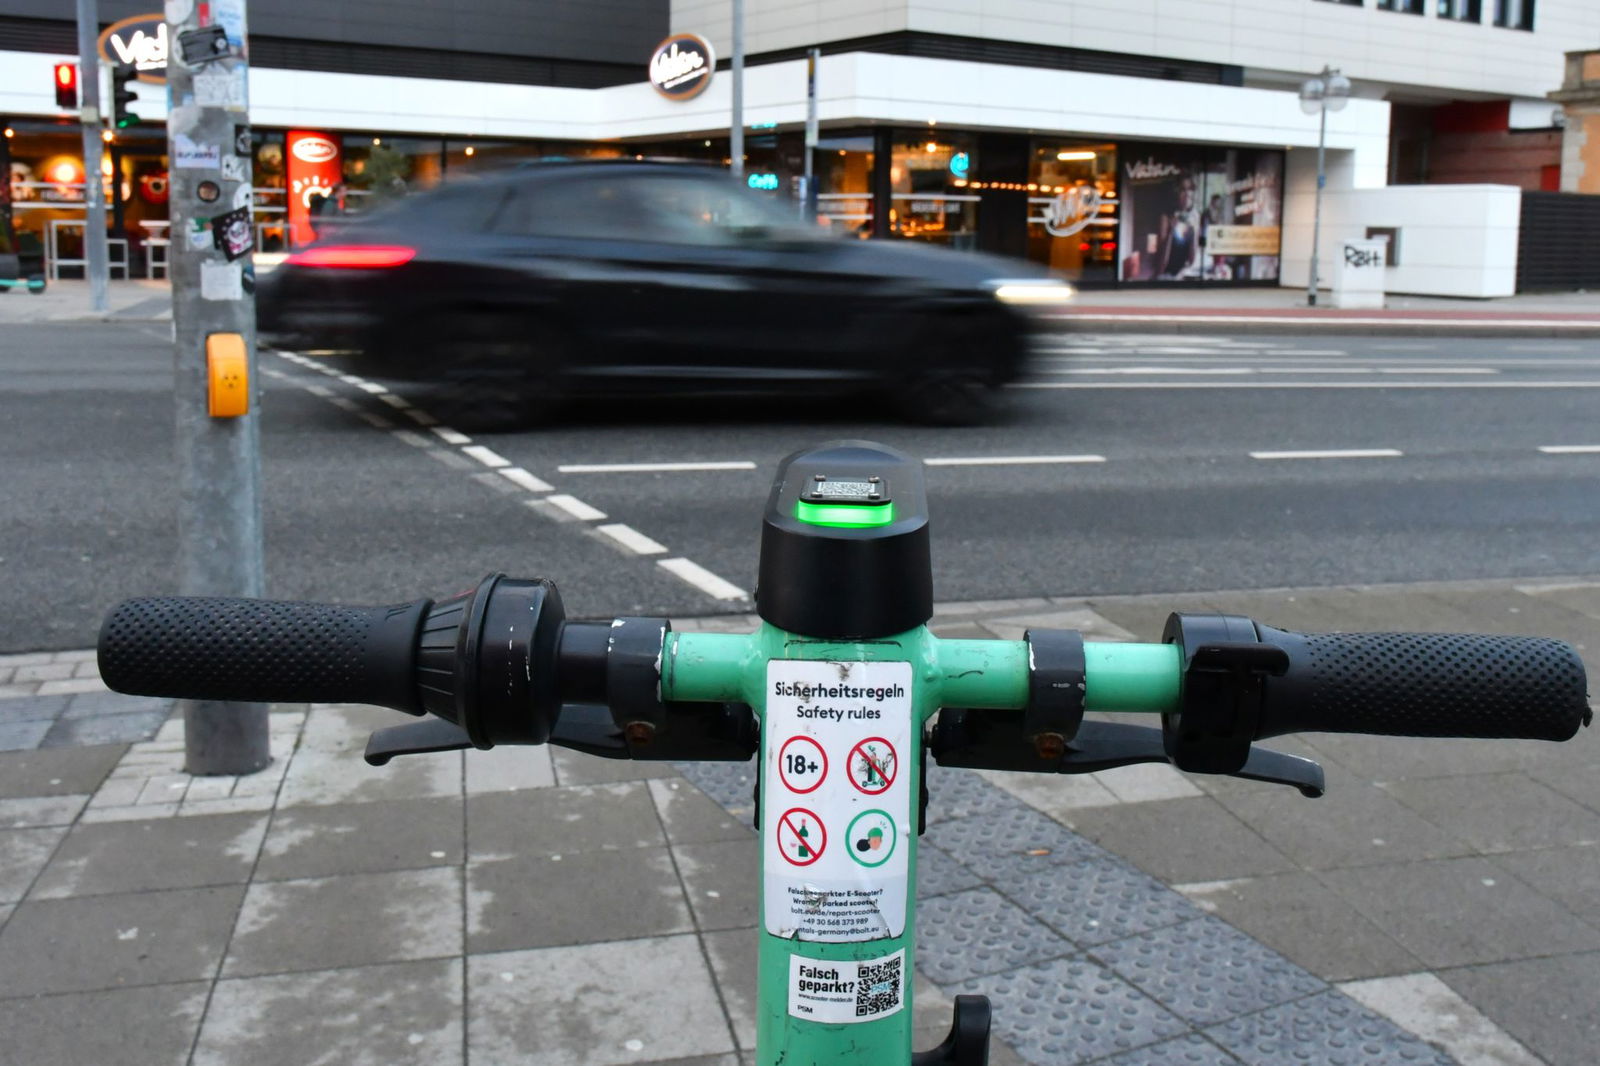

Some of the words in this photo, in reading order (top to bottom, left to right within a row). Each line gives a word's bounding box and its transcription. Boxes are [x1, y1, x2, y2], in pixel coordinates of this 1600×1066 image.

[775, 681, 904, 702] Sicherheitsregeln
[796, 704, 844, 722] Safety
[847, 705, 881, 719] rules
[785, 754, 819, 775] 18+
[822, 899, 848, 908] parked
[816, 918, 826, 926] 30
[799, 965, 839, 980] Falsch
[799, 980, 854, 993] geparkt?
[797, 1004, 814, 1014] PSM
